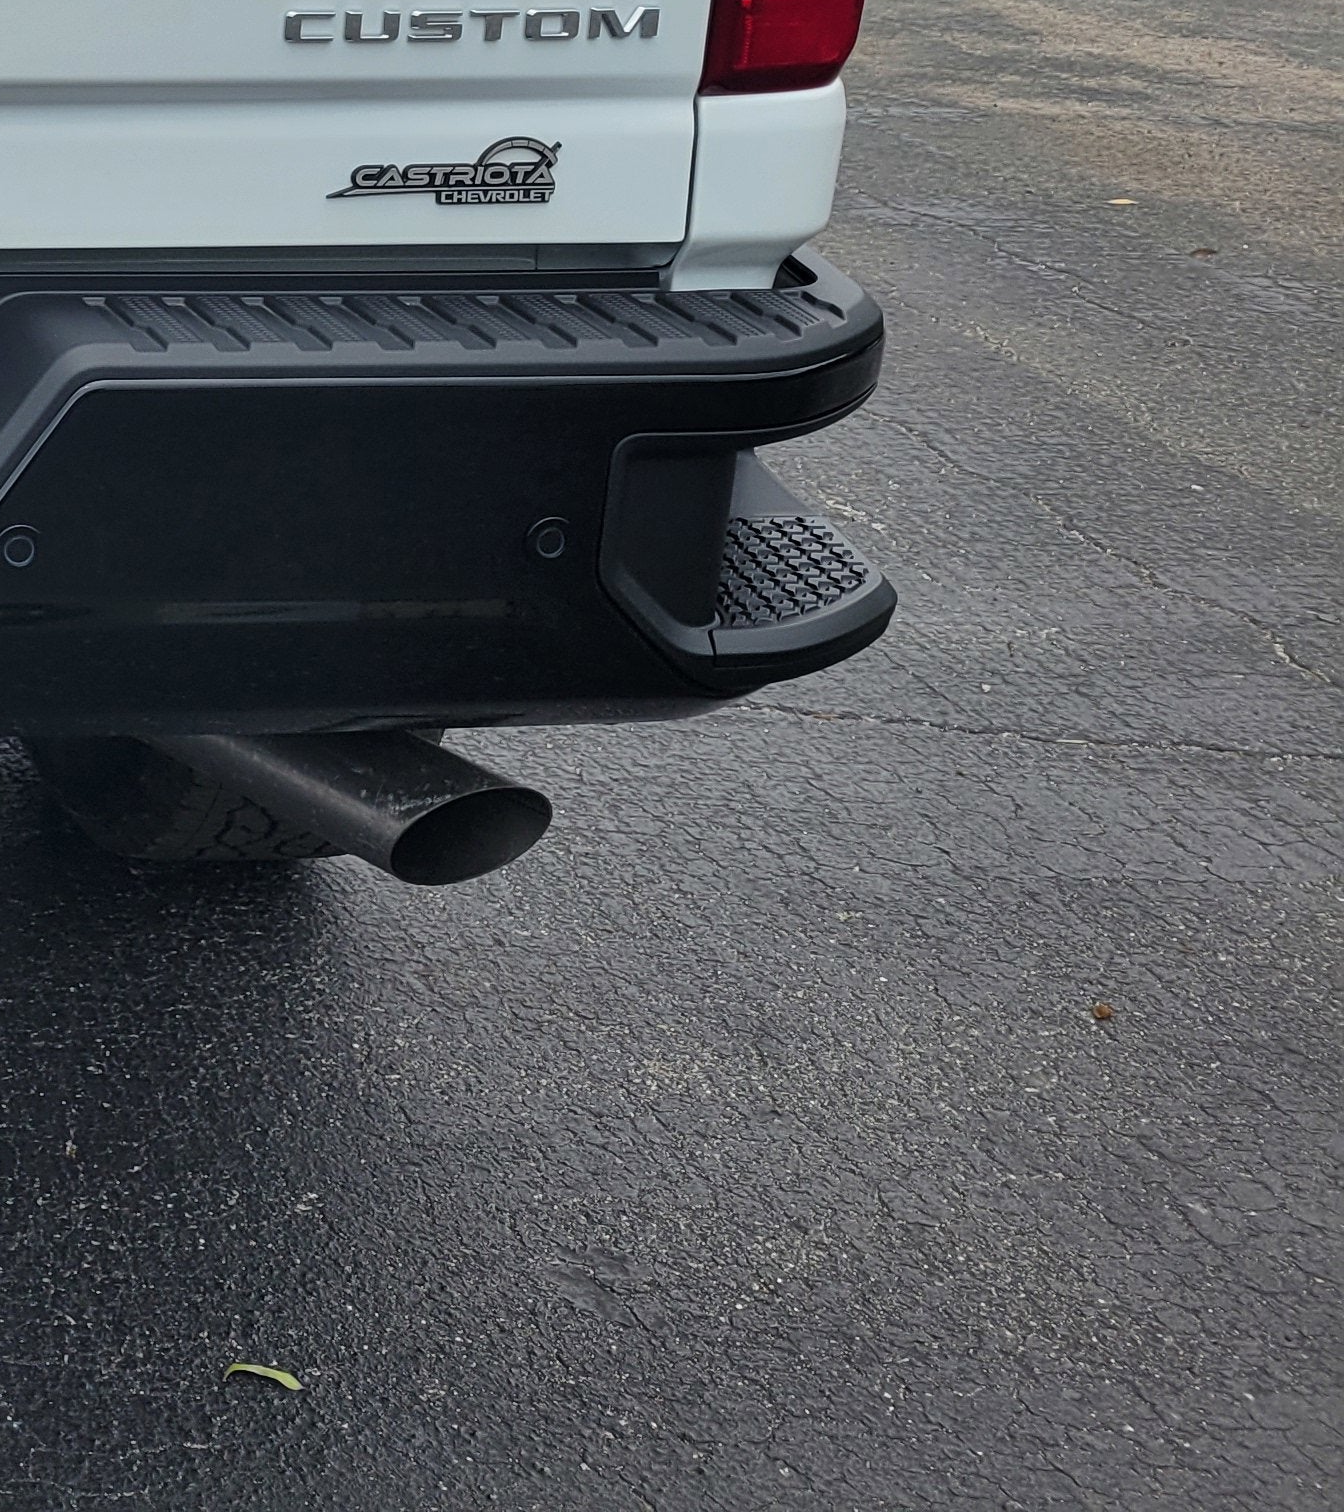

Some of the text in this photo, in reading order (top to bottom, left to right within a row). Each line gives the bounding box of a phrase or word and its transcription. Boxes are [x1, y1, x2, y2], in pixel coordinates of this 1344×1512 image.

[284, 5, 661, 42] CUSTOM
[353, 164, 554, 187] CASTRIOTA
[439, 188, 552, 204] CHEVROLET
